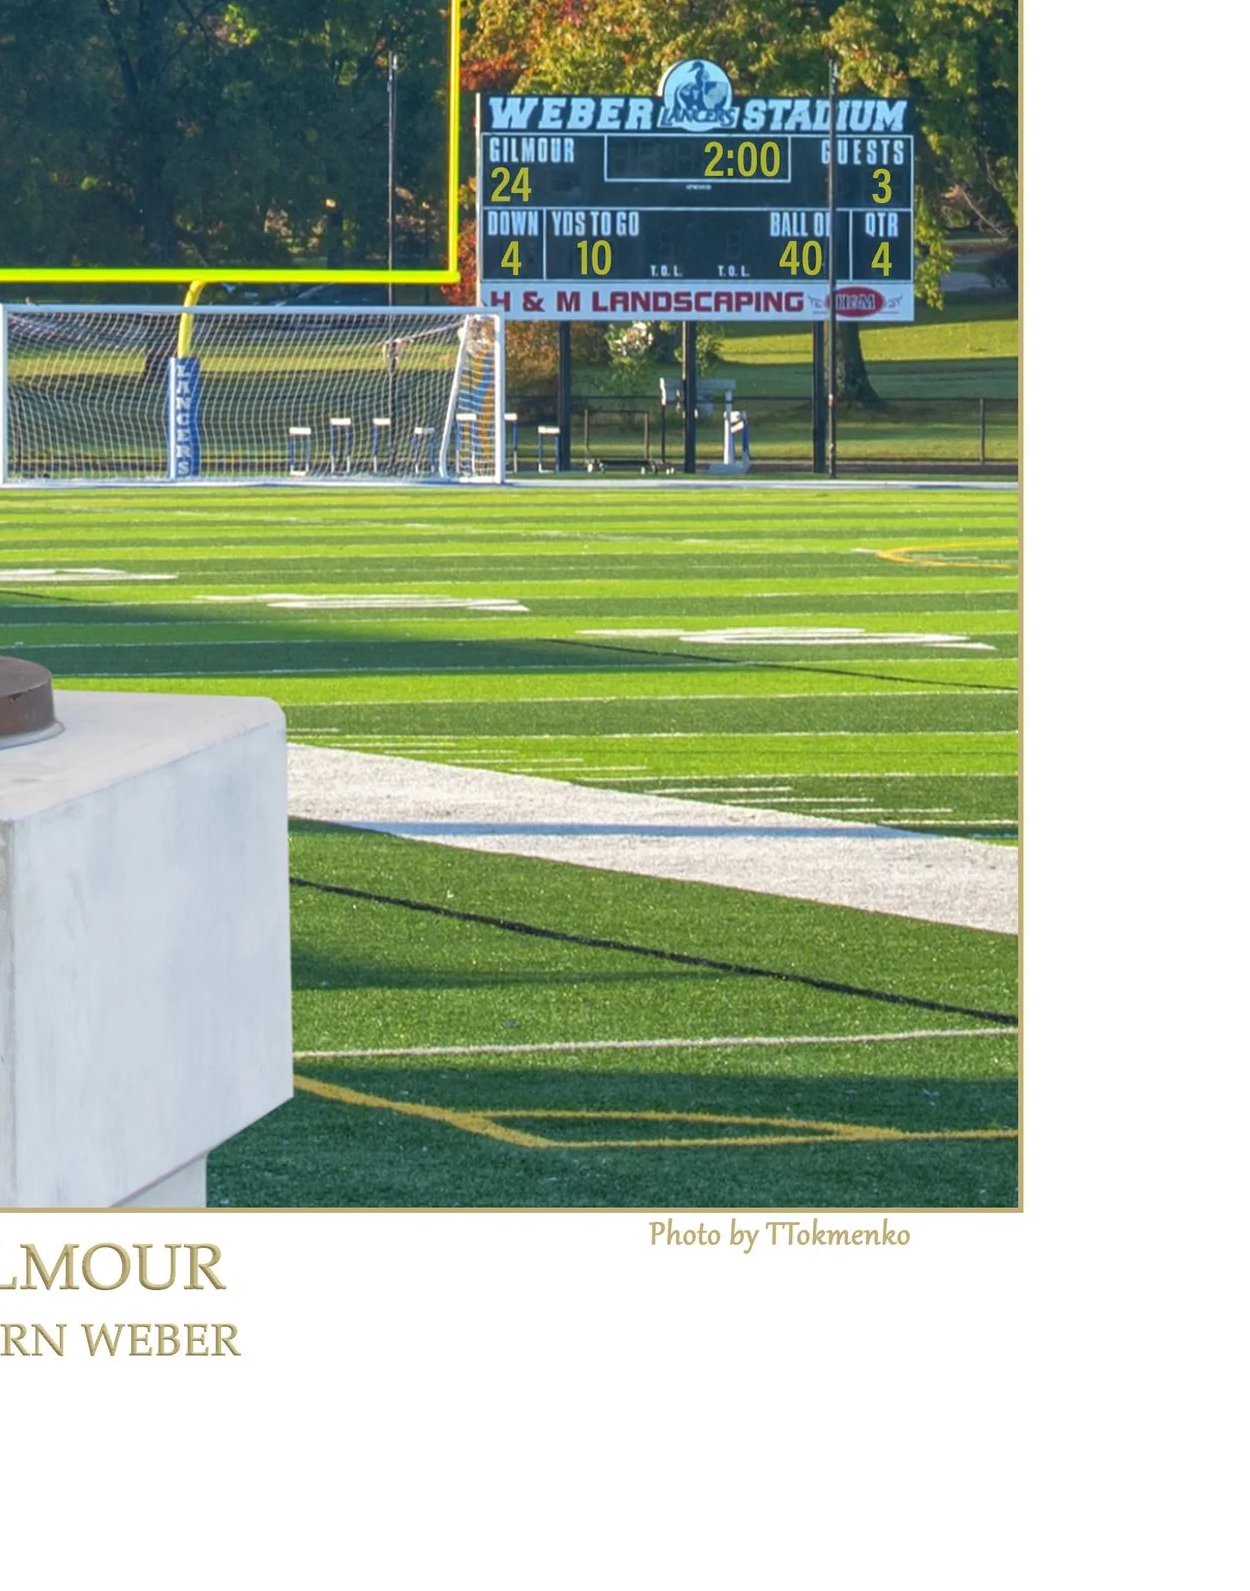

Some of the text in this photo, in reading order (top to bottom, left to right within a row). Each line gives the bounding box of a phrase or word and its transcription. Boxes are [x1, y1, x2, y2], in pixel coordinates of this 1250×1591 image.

[488, 97, 652, 130] WEBER
[659, 108, 736, 127] LANCERS
[742, 99, 908, 132] STADIUM
[490, 138, 575, 164] GILMOUR
[704, 141, 781, 177] 2:00
[821, 139, 904, 165] GUESTS
[490, 167, 532, 203] 24
[872, 169, 892, 204] 3
[487, 211, 539, 237] DOWN
[552, 211, 640, 237] YDS TO GO
[770, 212, 809, 238] BALL
[865, 212, 899, 238] QTR
[501, 241, 522, 276] 4
[577, 240, 612, 276] 10
[779, 240, 823, 276] 40
[871, 242, 893, 277] 4
[491, 291, 805, 313] H & M LANDSCAPING
[176, 363, 192, 476] LANCERS
